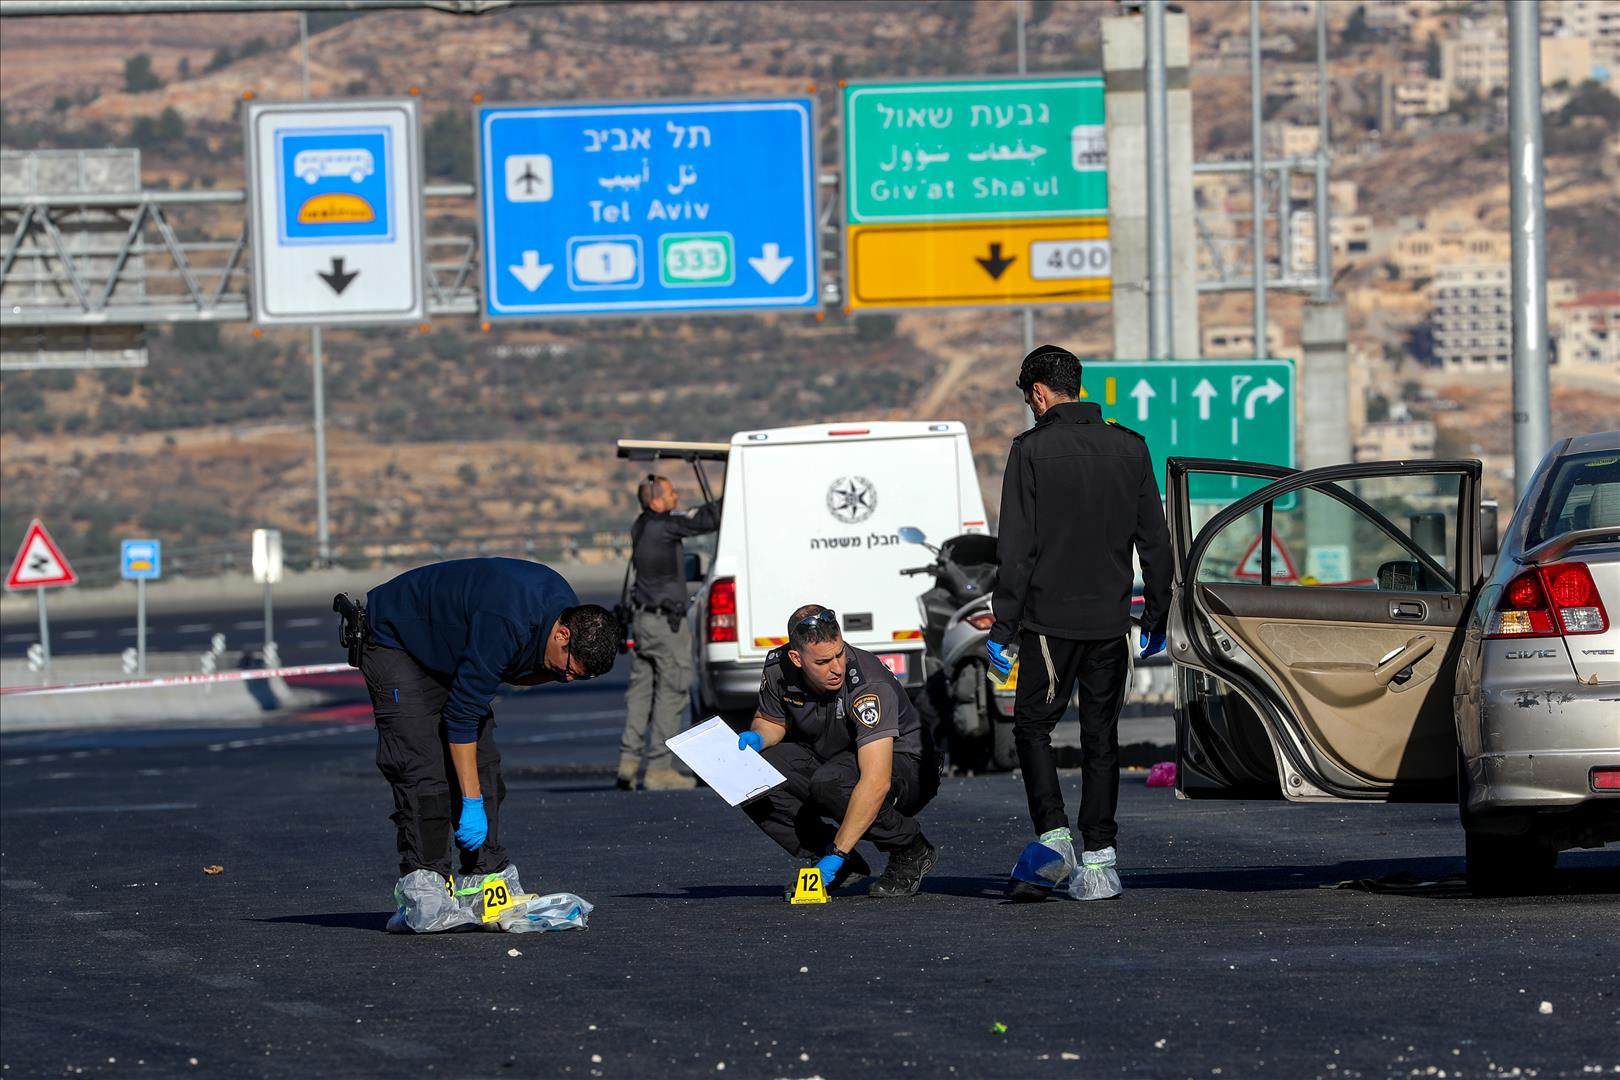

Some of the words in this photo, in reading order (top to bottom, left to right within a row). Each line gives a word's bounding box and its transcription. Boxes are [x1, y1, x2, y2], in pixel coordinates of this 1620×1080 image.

[876, 103, 953, 128] שאול
[970, 103, 1050, 128] גבעת
[583, 127, 651, 152] אביב
[666, 121, 711, 149] תל
[666, 164, 697, 195] تل
[589, 200, 630, 222] Tel
[648, 199, 709, 219] Aviv
[600, 251, 612, 274] 1
[672, 248, 721, 271] 333
[1047, 246, 1107, 271] 400
[810, 536, 861, 549] משטרה
[867, 532, 899, 549] חבלן
[1505, 649, 1557, 660] CIVIC
[802, 874, 818, 891] 12
[485, 886, 507, 908] 29
